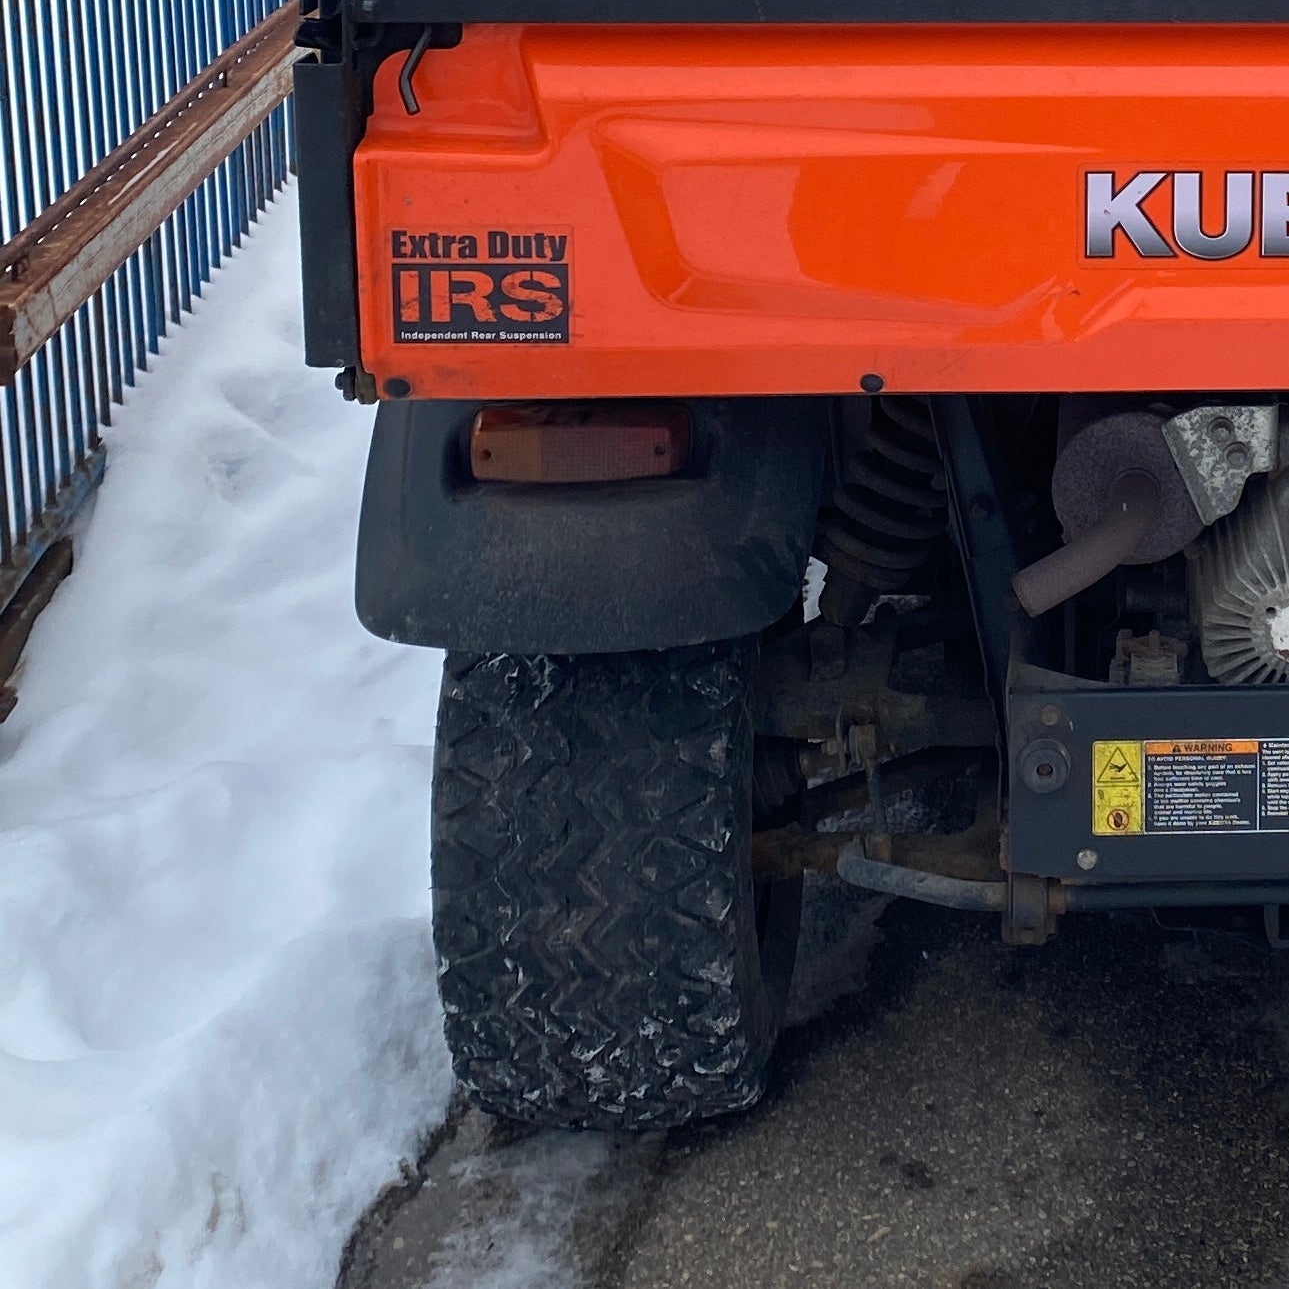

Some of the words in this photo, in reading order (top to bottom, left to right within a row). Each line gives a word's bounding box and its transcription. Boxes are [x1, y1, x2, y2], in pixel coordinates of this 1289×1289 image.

[391, 230, 478, 259] Extra
[487, 231, 568, 262] Duty
[400, 271, 564, 323] IRS
[401, 331, 468, 341] Independent
[471, 331, 496, 340] Rear
[499, 331, 562, 341] Suspension
[1184, 743, 1233, 752] WARNING
